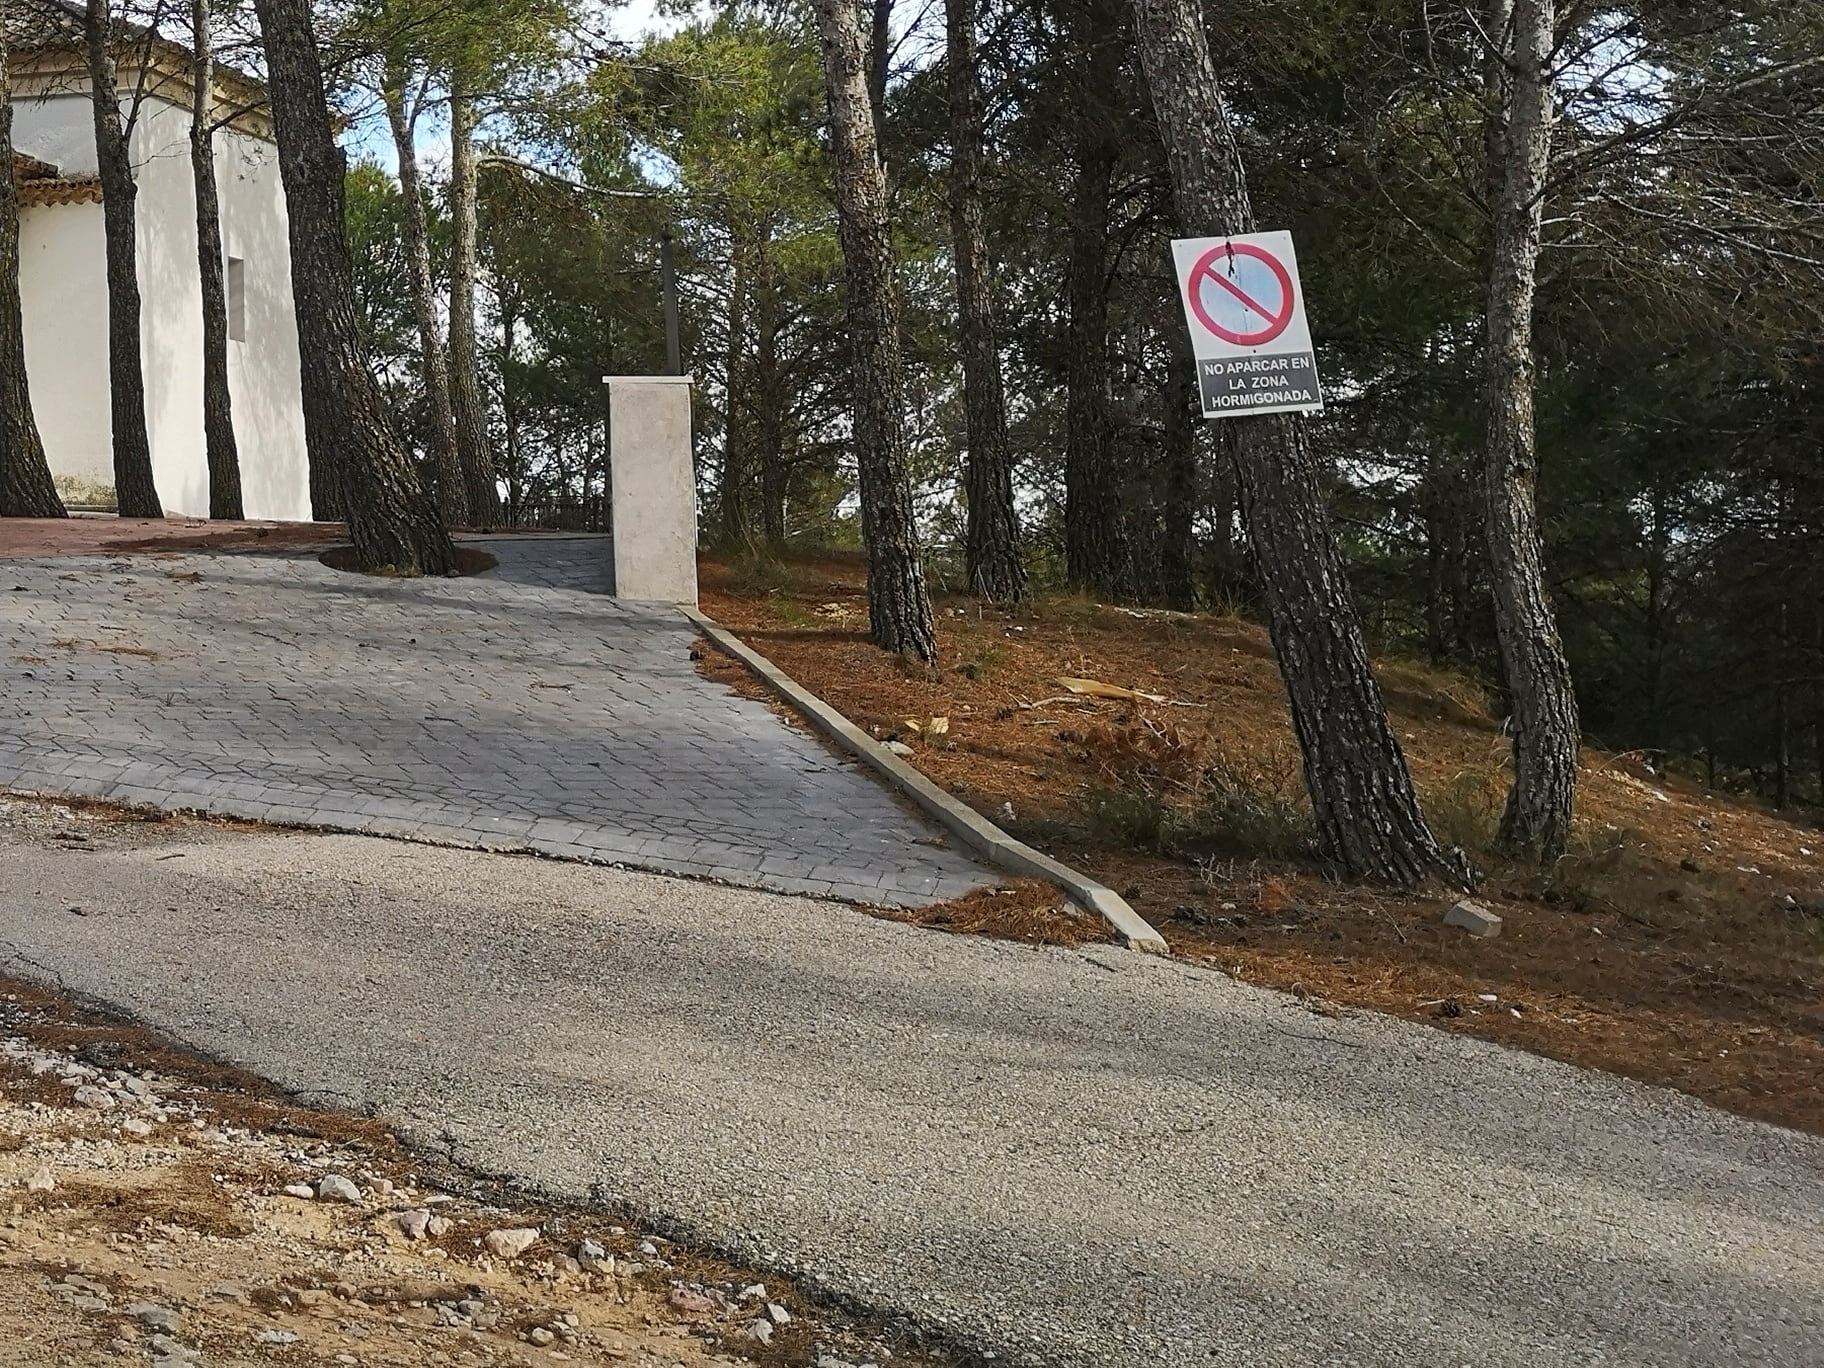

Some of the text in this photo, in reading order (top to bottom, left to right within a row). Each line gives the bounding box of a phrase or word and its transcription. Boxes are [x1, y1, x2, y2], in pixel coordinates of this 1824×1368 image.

[1204, 356, 1310, 376] NO APARCAR EN
[1228, 375, 1289, 390] LA ZONA
[1211, 389, 1312, 408] HORMIGONADA
